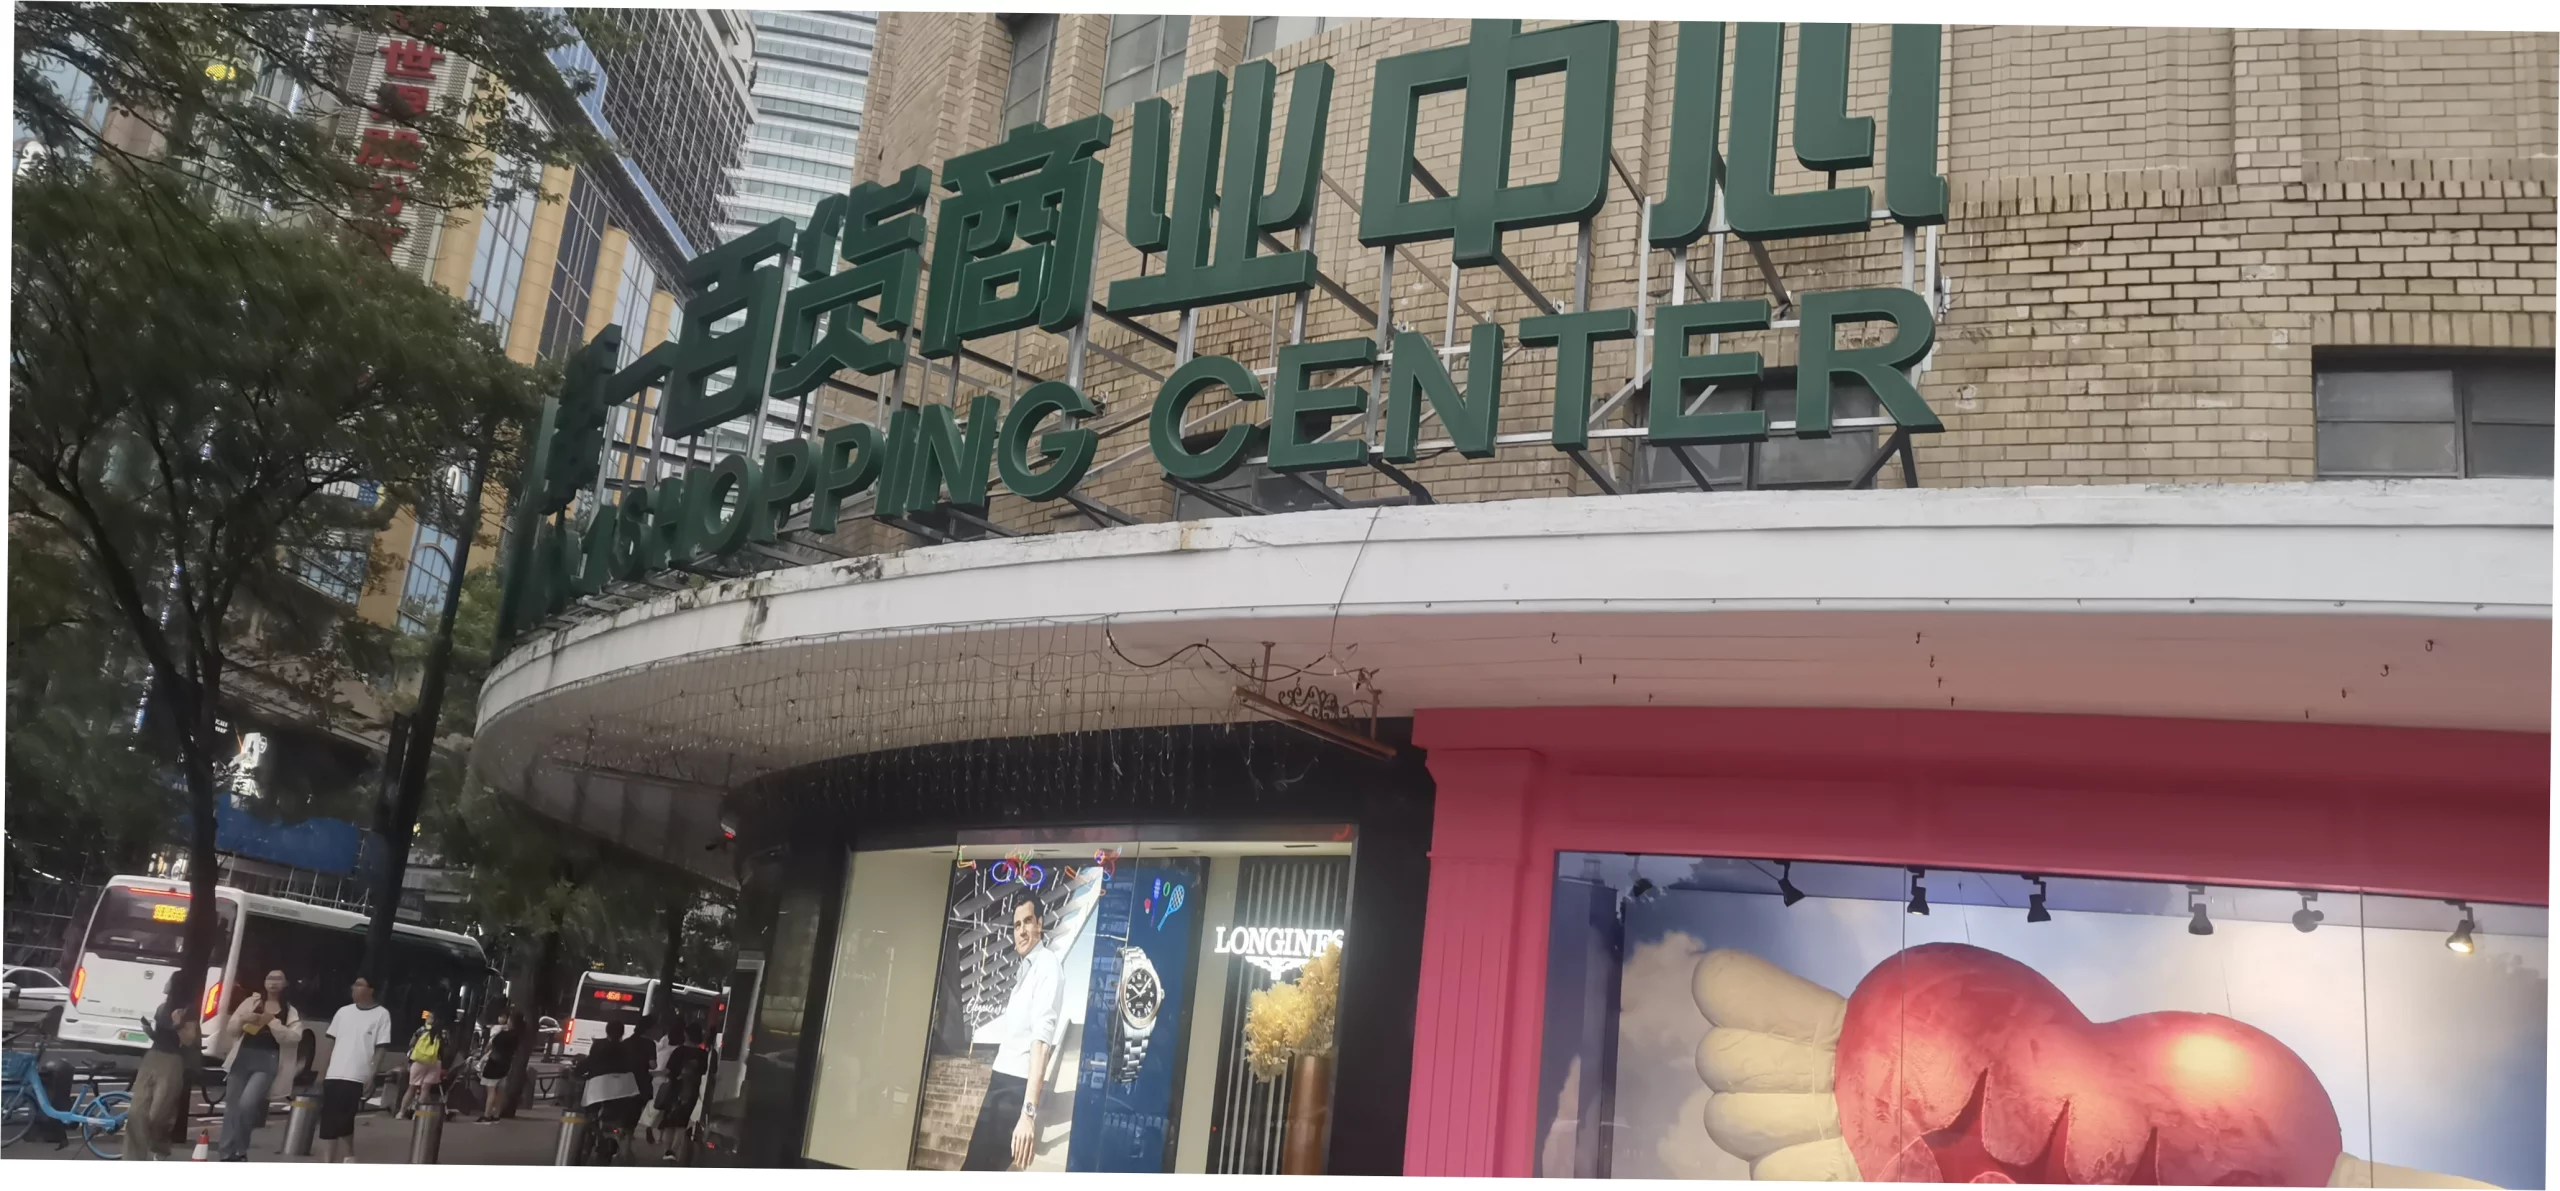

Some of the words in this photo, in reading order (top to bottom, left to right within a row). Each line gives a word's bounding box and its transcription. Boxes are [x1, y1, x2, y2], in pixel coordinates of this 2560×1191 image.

[605, 381, 1099, 583] SHOPPING
[1149, 288, 1946, 484] CENTER
[1214, 926, 1345, 957] LONGINES
